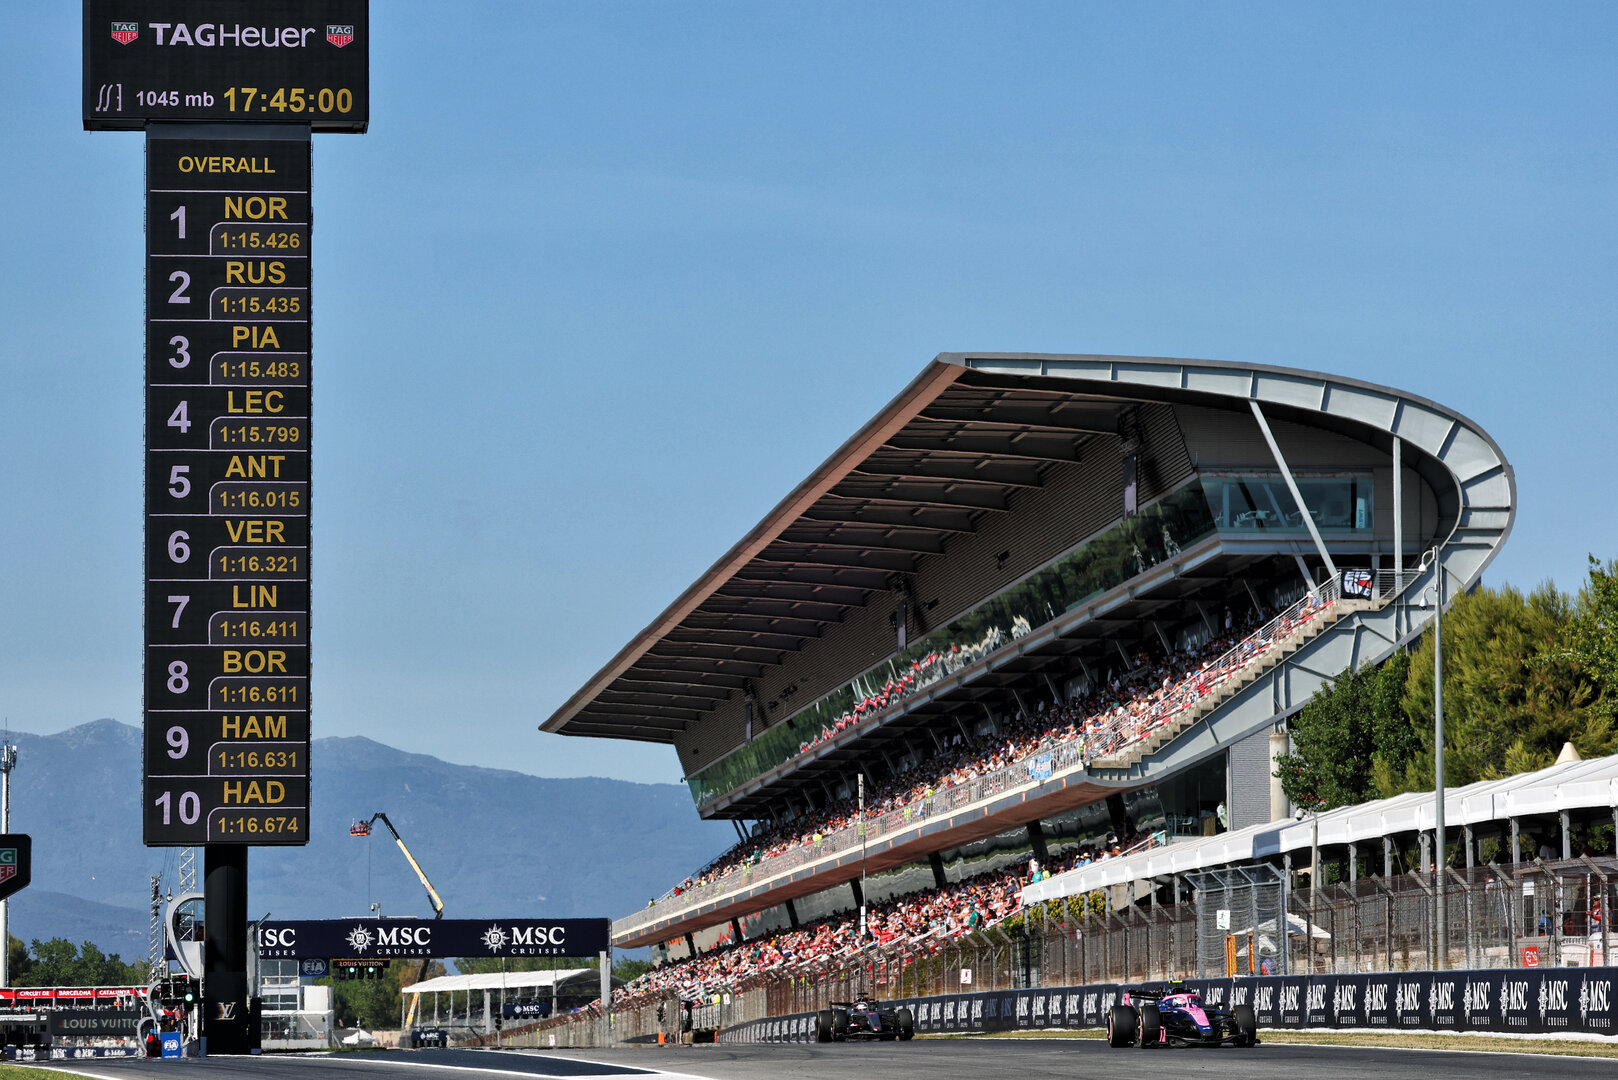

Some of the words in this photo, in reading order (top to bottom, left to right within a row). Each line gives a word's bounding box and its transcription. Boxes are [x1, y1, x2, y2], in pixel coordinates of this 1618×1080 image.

[112, 32, 138, 43] HEUER
[149, 23, 316, 47] TAGHeuer
[328, 35, 353, 46] HEUER
[137, 91, 179, 106] 1045
[186, 92, 214, 106] mb
[224, 88, 352, 112] 17:45:00
[179, 157, 275, 173] OVERALL
[225, 197, 288, 219] NOR
[171, 206, 185, 238] 1
[221, 232, 299, 248] 1:15.426
[227, 262, 285, 283] RUS
[168, 271, 190, 303] 2
[221, 297, 299, 312] 1:15.435
[233, 326, 280, 348] PIA
[169, 336, 190, 368] 3
[221, 362, 299, 377] 1:15.483
[228, 391, 283, 413] LEC
[168, 401, 191, 433] 4
[221, 427, 298, 442] 1:15.799
[225, 456, 285, 477] ANT
[169, 466, 190, 498] 5
[220, 491, 299, 507] 1:16.015
[226, 521, 285, 542] VER
[168, 530, 190, 563] 6
[220, 556, 296, 571] 1:16.321
[233, 586, 276, 607] LIN
[168, 596, 189, 628] 7
[220, 621, 296, 636] 1:16.411
[224, 650, 287, 672] BOR
[167, 661, 189, 693] 8
[220, 687, 296, 702] 1:16.611
[223, 716, 286, 738] HAM
[167, 726, 189, 759] 9
[219, 752, 295, 767] 1:16.631
[224, 781, 285, 803] HAD
[156, 791, 200, 824] 10
[219, 817, 298, 833] 1:16.674
[378, 927, 430, 946] MSC
[512, 927, 564, 945] MSC
[304, 963, 323, 971] FIA
[1260, 987, 1273, 1010] MSC
[1286, 986, 1299, 1010] MSC
[1311, 985, 1326, 1009] MSC
[1341, 985, 1356, 1010] MSC
[1372, 984, 1388, 1010] MSC
[1404, 983, 1420, 1010] MSC
[1437, 982, 1454, 1009] MSC
[1473, 982, 1490, 1010] MSC
[1509, 982, 1528, 1010] MSC
[1548, 981, 1568, 1010] MSC
[1590, 981, 1611, 1011] MSC
[64, 1019, 98, 1029] LOUIS
[101, 1018, 139, 1028] VUITTO
